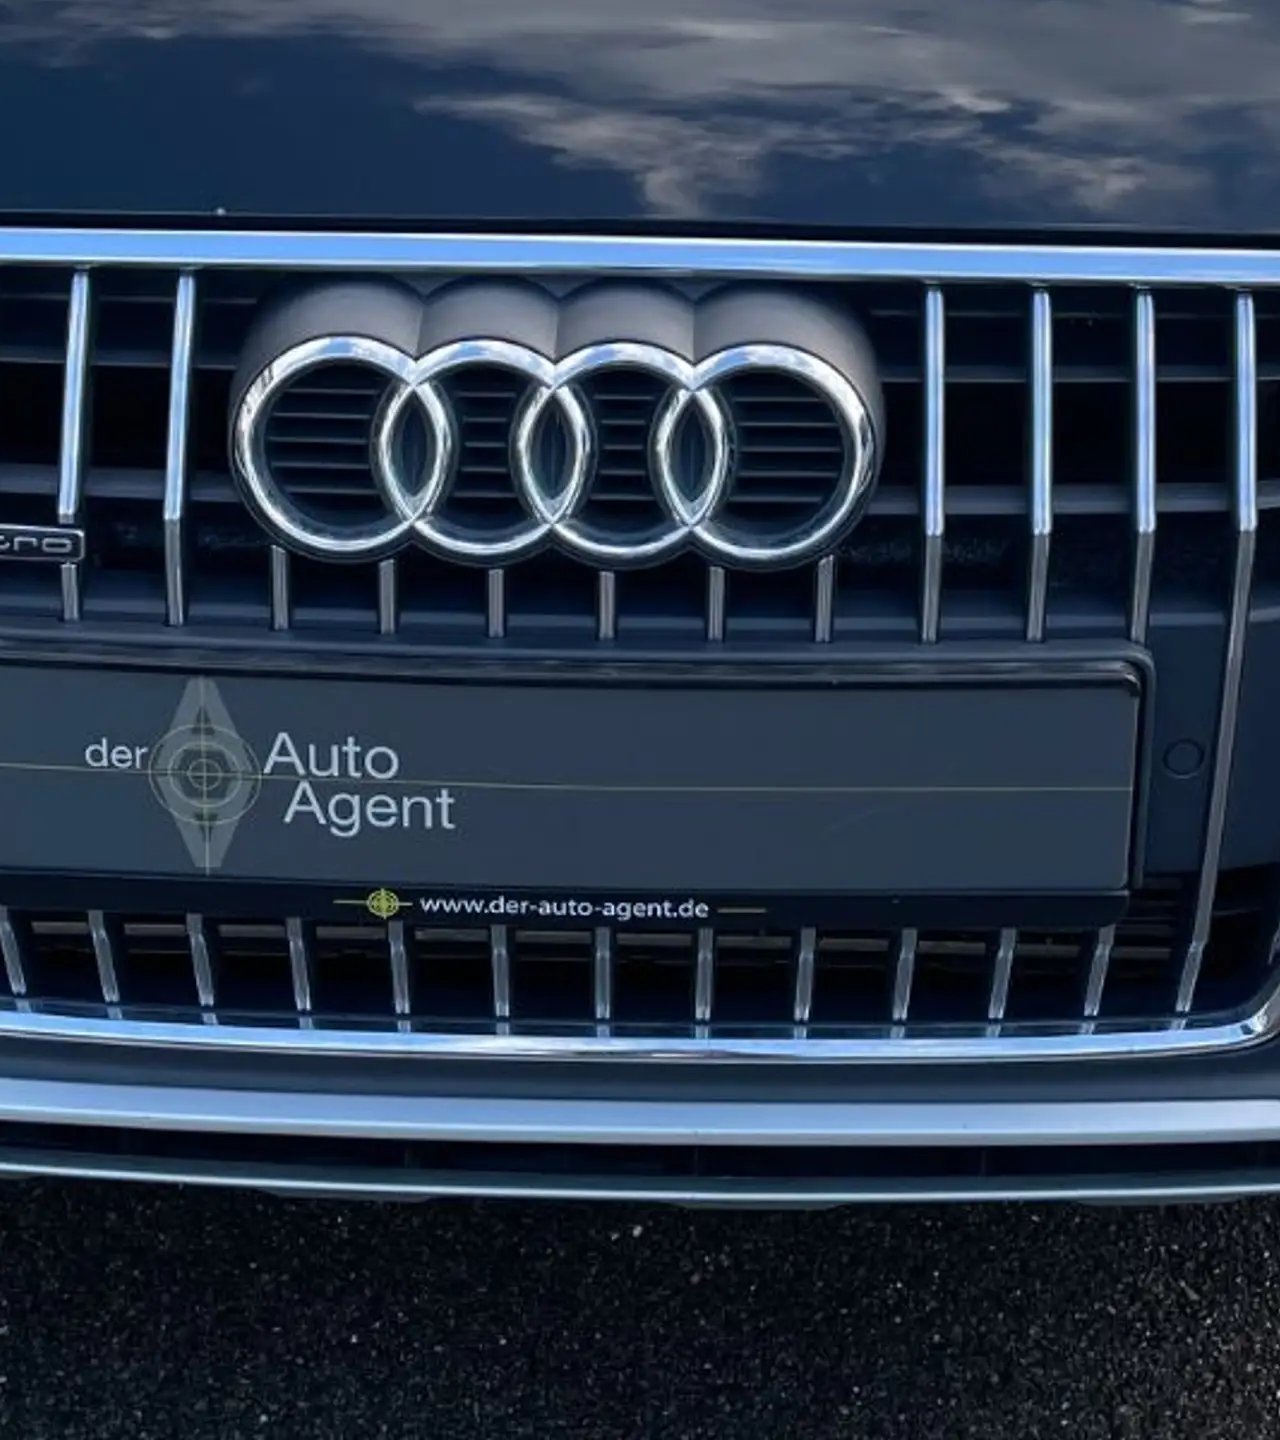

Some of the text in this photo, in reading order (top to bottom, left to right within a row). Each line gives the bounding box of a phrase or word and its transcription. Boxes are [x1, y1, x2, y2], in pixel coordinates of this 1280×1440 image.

[84, 731, 400, 780] der Auto
[283, 779, 456, 838] Agent
[419, 894, 710, 921] www.der-auto-agent.de
